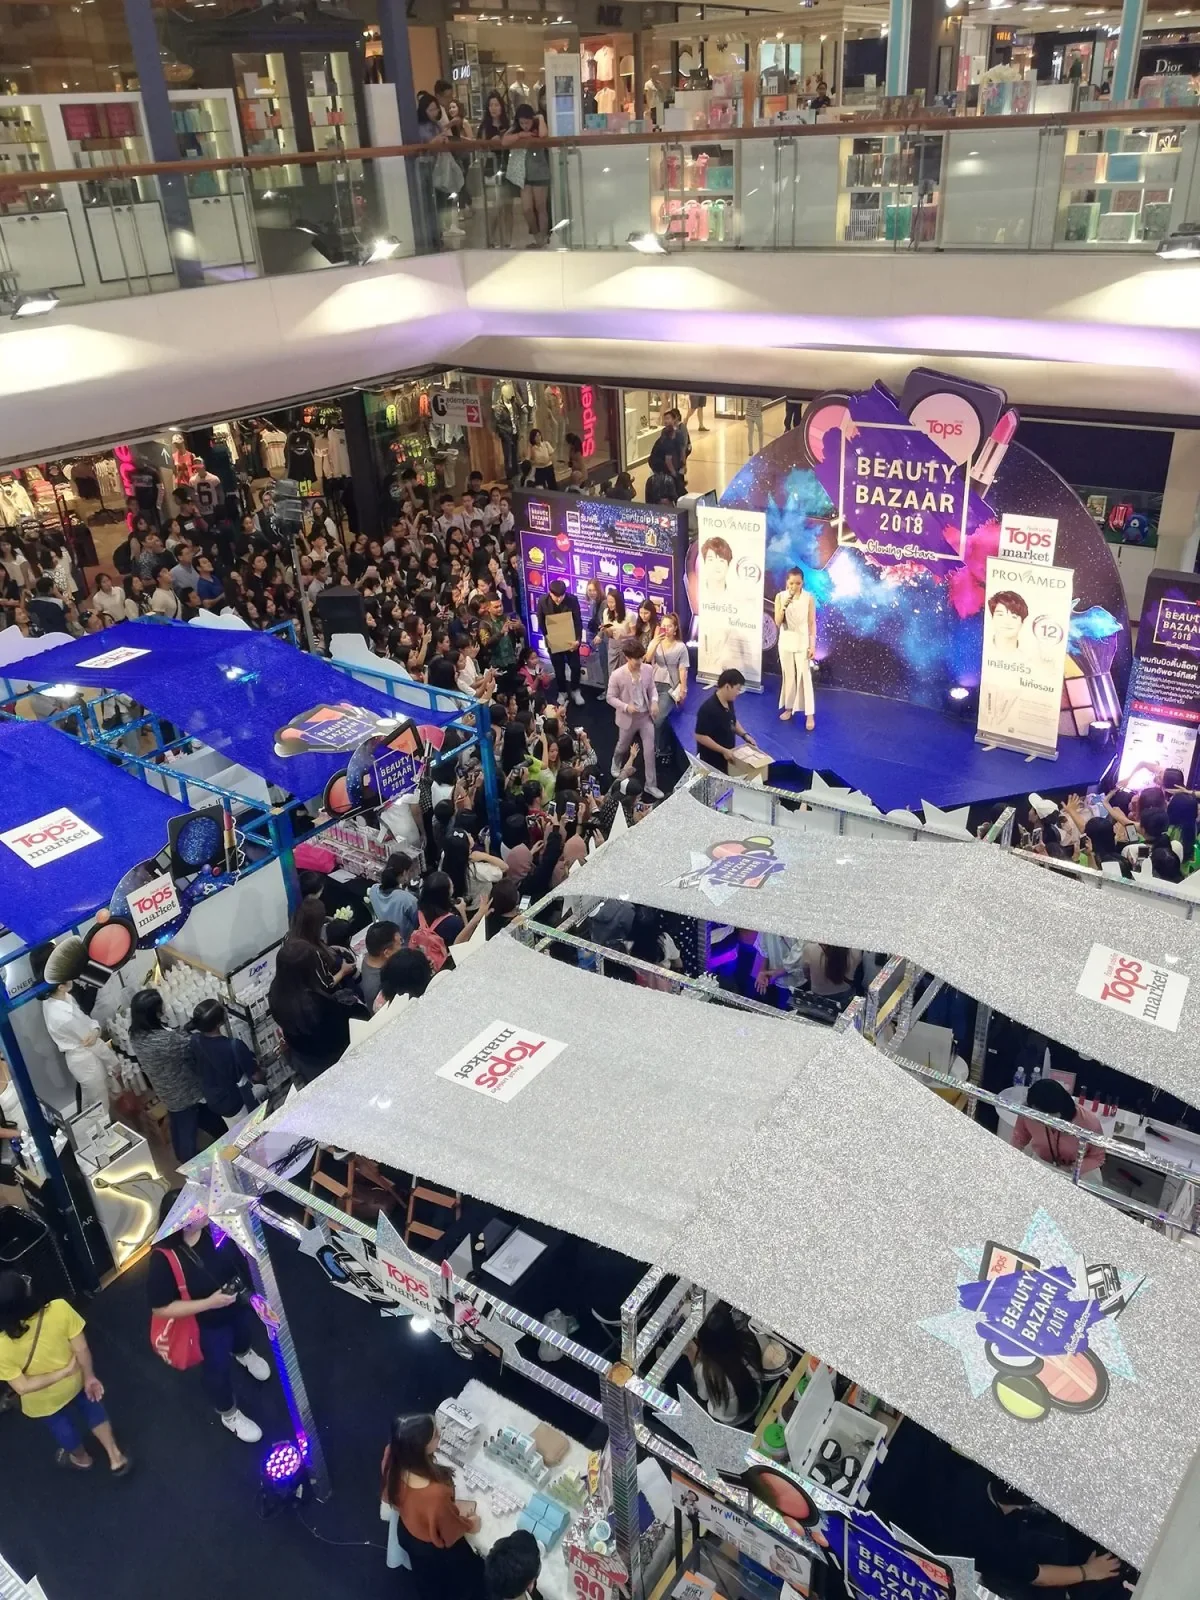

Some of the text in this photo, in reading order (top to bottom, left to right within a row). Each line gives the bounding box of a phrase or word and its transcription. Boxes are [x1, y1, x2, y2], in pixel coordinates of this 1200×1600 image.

[1154, 58, 1184, 74] Dior
[926, 419, 963, 439] Tops
[857, 456, 957, 485] BEAUTY
[855, 484, 954, 514] BAZAAR
[703, 516, 761, 533] PROVAMED
[879, 513, 923, 535] 2018
[867, 539, 935, 560] Glowing Stars
[1005, 527, 1052, 551] Tops
[1002, 548, 1050, 563] market
[743, 566, 756, 578] 12
[992, 569, 1067, 590] PROVAMED
[1163, 621, 1200, 634] BAZAA
[1165, 609, 1200, 624] BEAUT
[1041, 624, 1058, 639] 12
[987, 659, 1032, 675] เคลียร์เร็ว
[1019, 676, 1054, 693] ไม่ทิ้งรอย
[317, 717, 350, 738] BEAUTY
[325, 721, 359, 741] BAZAAR
[380, 754, 410, 777] BEAUTY
[382, 765, 412, 787] BAZAAR
[11, 818, 78, 849] Tops
[27, 828, 90, 860] market
[132, 887, 173, 914] Tops
[138, 900, 177, 928] market
[248, 960, 268, 978] Dove
[1100, 957, 1148, 1004] Tops
[1143, 969, 1169, 1021] market
[454, 1028, 516, 1080] market
[475, 1040, 547, 1089] Tops
[990, 1255, 1007, 1274] Tops
[381, 1259, 429, 1298] Tops
[385, 1280, 432, 1312] market
[1001, 1270, 1038, 1330] BEAUTY
[1021, 1282, 1058, 1342] BAZAAR
[1046, 1307, 1069, 1337] 2018
[710, 1503, 749, 1527] MY WHEY
